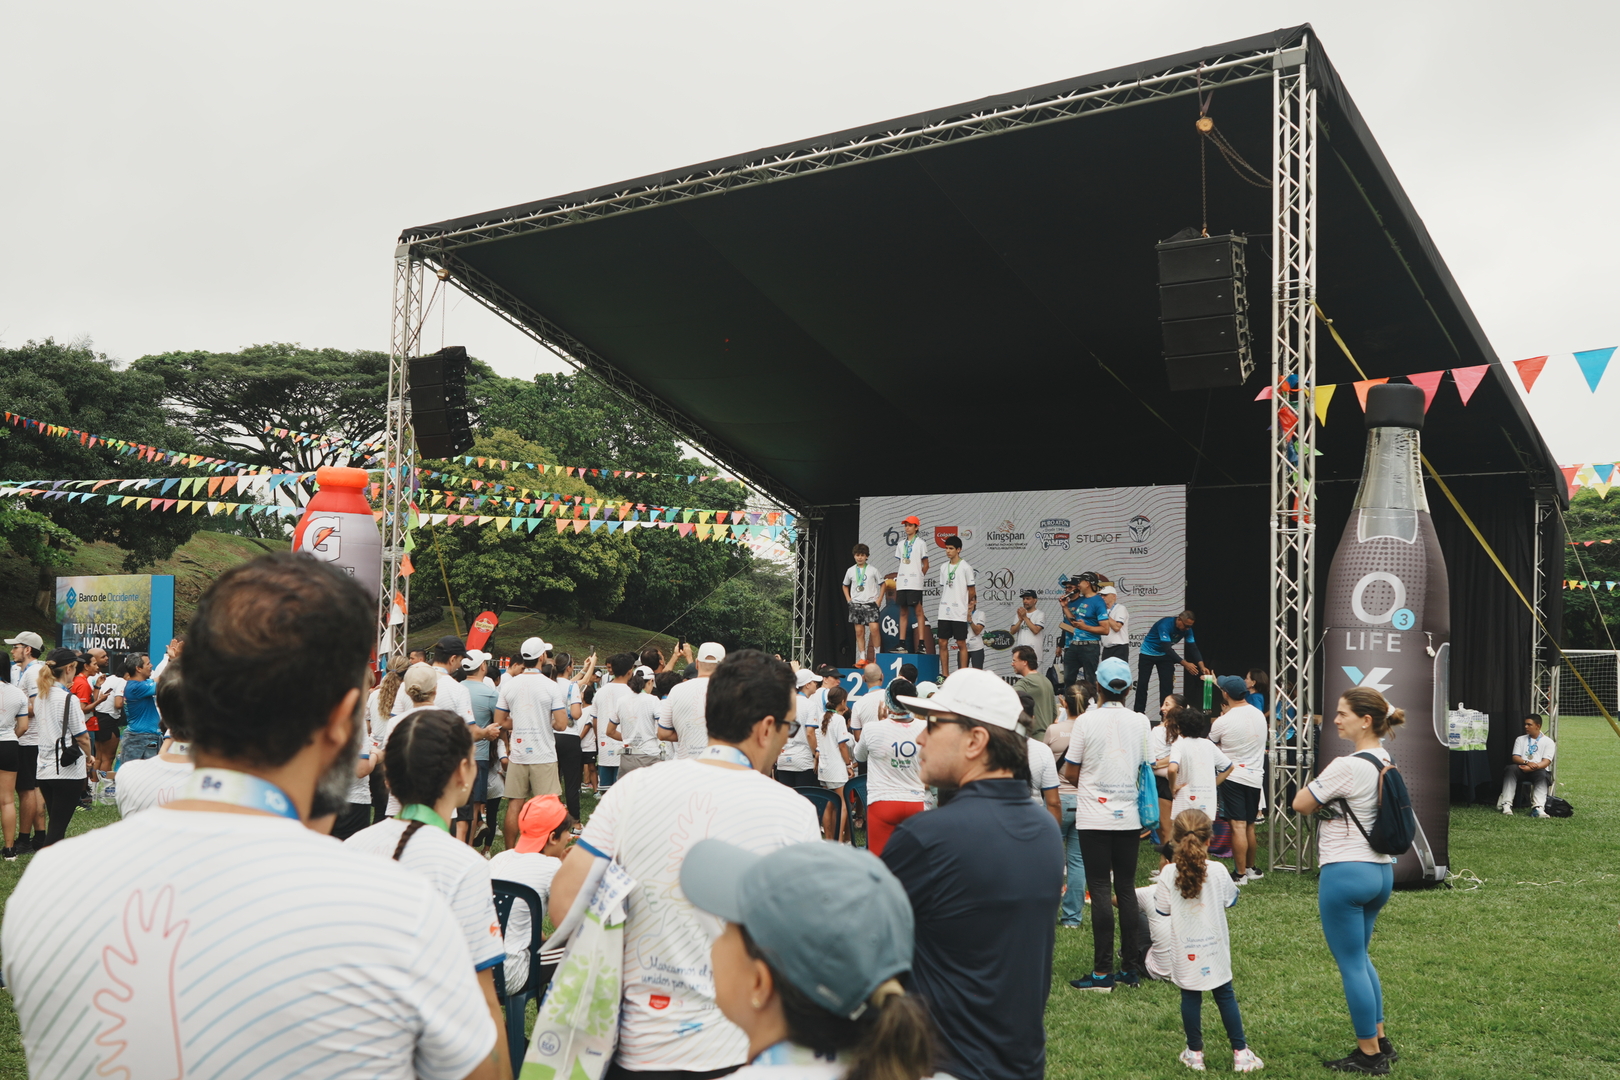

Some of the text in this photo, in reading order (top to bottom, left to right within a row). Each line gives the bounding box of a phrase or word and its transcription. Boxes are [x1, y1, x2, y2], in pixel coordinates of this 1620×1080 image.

[986, 531, 1025, 542] Kingspan
[1076, 533, 1121, 543] STUDIO F
[79, 592, 139, 602] Banco de Occidente
[982, 589, 1016, 601] GROUP
[73, 623, 120, 636] TU HACER,
[83, 637, 130, 650] IMPACTA.
[1346, 632, 1401, 652] LIFE
[890, 657, 903, 678] 1
[846, 671, 865, 701] 2
[891, 740, 916, 757] 10
